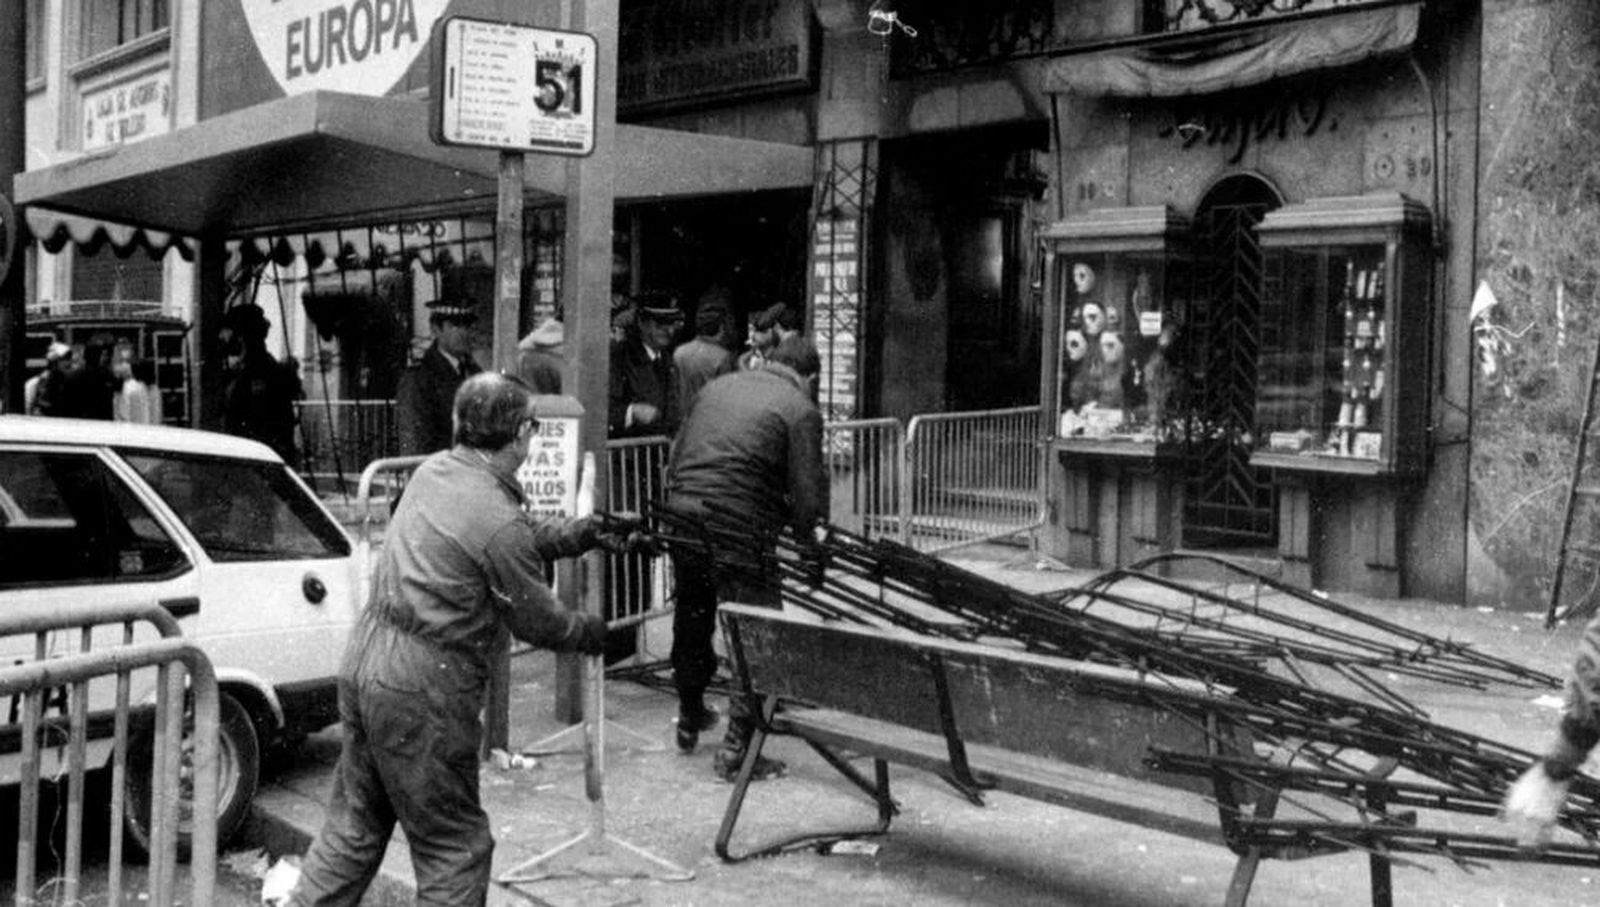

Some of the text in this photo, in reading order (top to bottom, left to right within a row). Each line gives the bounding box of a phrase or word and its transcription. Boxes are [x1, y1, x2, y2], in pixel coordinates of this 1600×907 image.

[286, 0, 418, 81] EUROPA
[533, 60, 582, 115] 51
[539, 421, 565, 437] JES
[524, 480, 566, 496] ALOS
